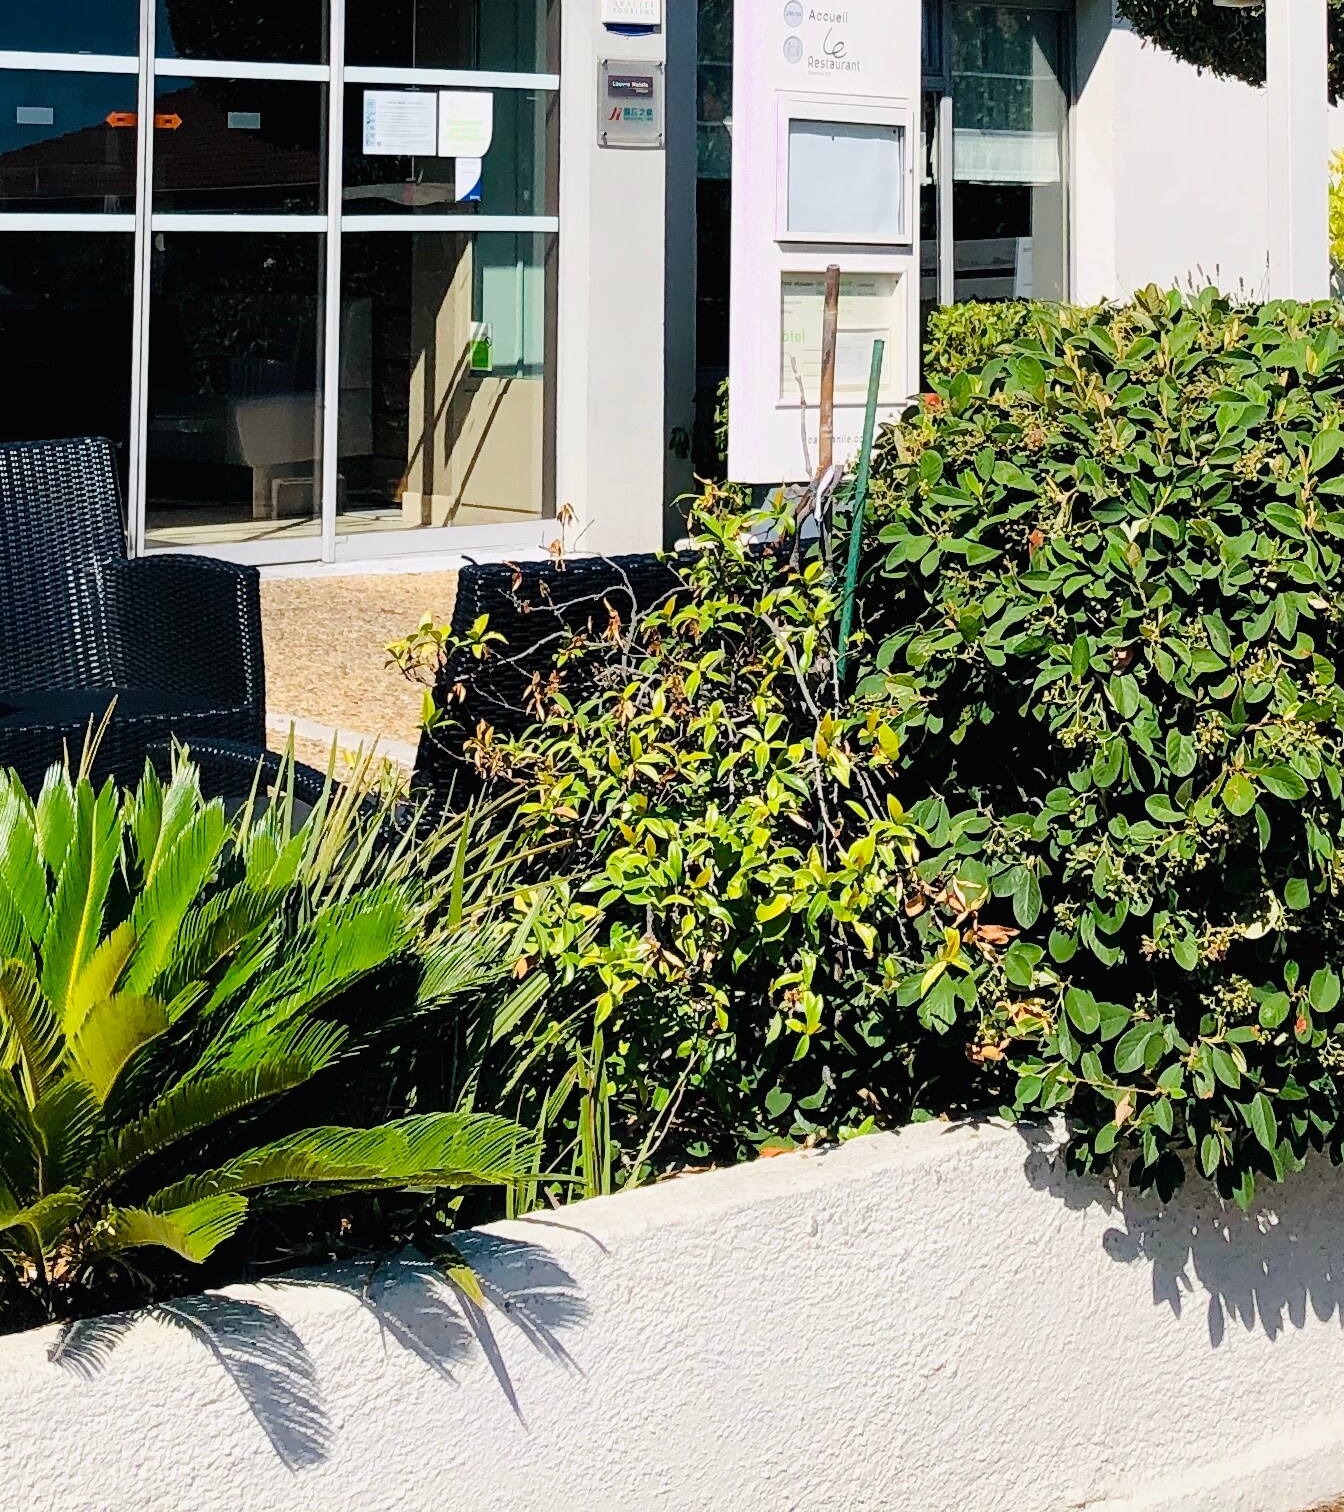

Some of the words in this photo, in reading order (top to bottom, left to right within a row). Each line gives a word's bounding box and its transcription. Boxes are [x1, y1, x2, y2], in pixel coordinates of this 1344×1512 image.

[808, 9, 849, 24] Accueil
[807, 55, 861, 72] Restaurant
[782, 329, 806, 343] ôtel
